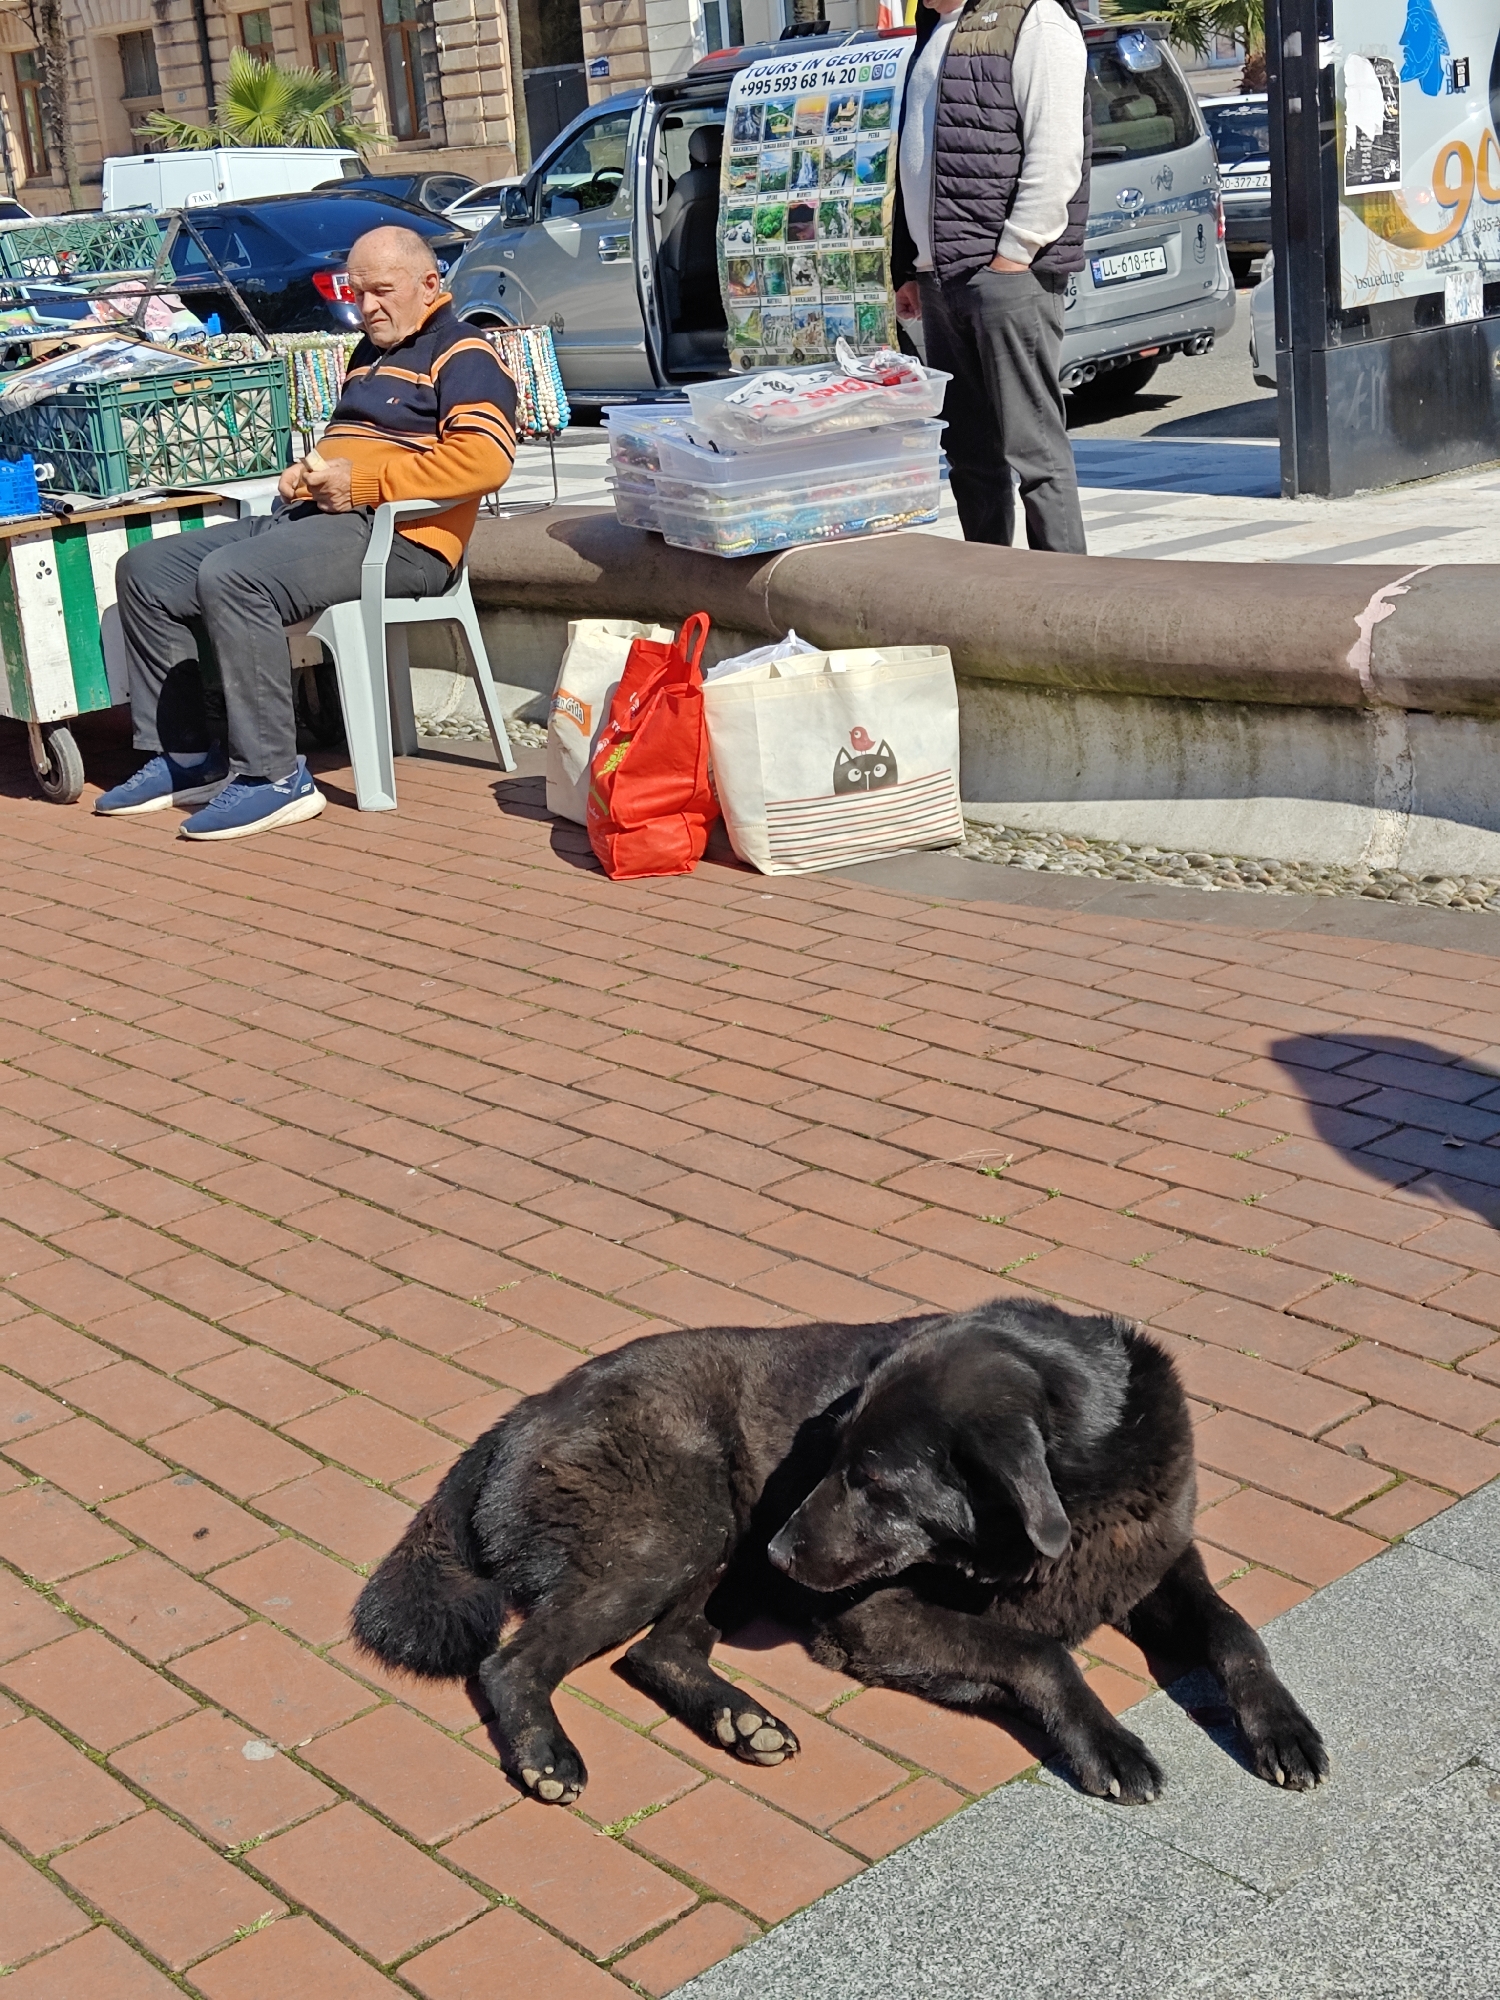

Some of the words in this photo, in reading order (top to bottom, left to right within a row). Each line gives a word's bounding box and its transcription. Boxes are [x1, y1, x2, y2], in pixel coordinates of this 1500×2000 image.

[746, 61, 801, 79] TOURS
[802, 57, 824, 71] IN
[826, 47, 904, 67] GEORGIA
[740, 80, 771, 96] +995
[774, 76, 797, 92] 593
[800, 73, 817, 89] 68
[822, 71, 835, 87] 14
[839, 68, 856, 84] 20
[192, 193, 212, 203] TAXI
[1102, 251, 1155, 276] LL-618-FF
[1354, 270, 1405, 289] bsu.edu.ge
